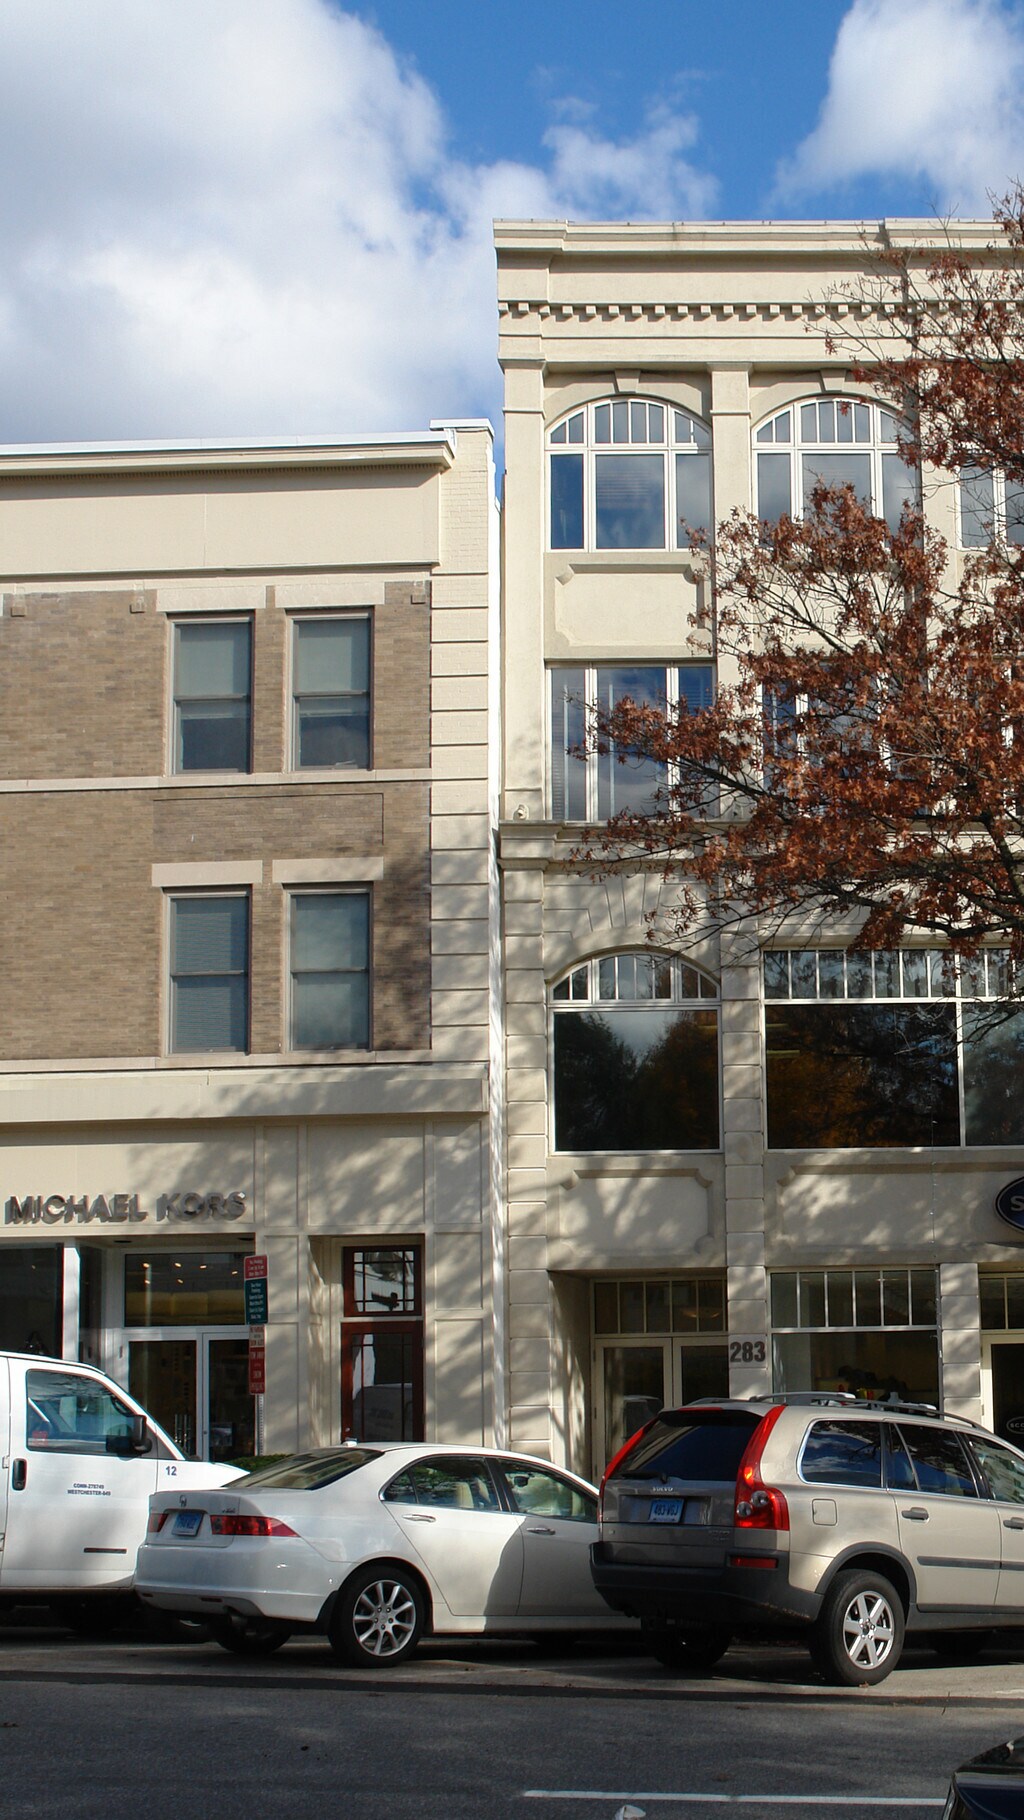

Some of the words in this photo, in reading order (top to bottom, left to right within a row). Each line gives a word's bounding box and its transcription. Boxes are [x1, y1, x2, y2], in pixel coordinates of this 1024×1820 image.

[4, 1194, 148, 1224] MICHAEL
[156, 1191, 247, 1222] KORS
[730, 1341, 766, 1362] 283
[165, 1465, 177, 1476] 12
